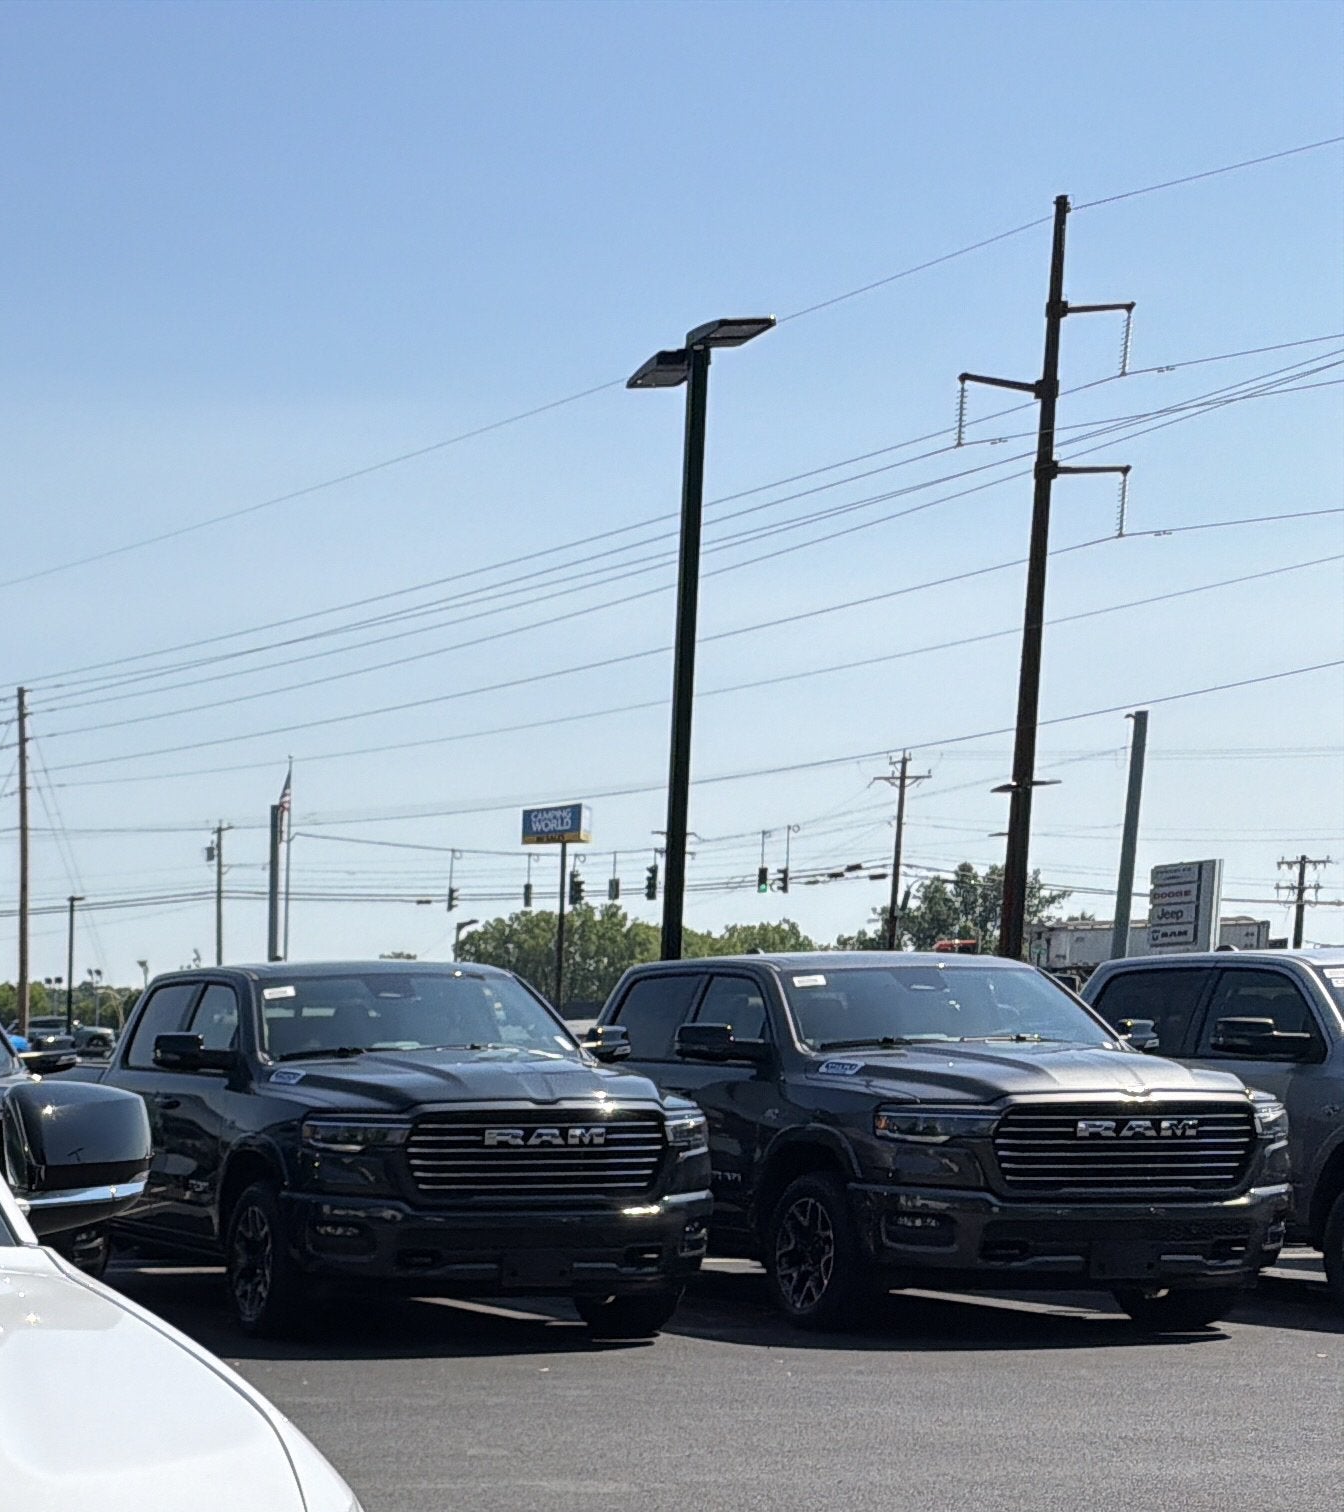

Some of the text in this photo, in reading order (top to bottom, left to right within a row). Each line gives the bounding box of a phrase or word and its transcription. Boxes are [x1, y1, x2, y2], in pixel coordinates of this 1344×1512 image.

[531, 808, 571, 821] CAMPING
[532, 818, 572, 832] WORLD
[1153, 890, 1192, 900] DODGE
[1156, 908, 1184, 920] Jeep
[1160, 930, 1188, 939] RAM
[1077, 1120, 1198, 1137] RAM
[484, 1128, 606, 1146] RAM
